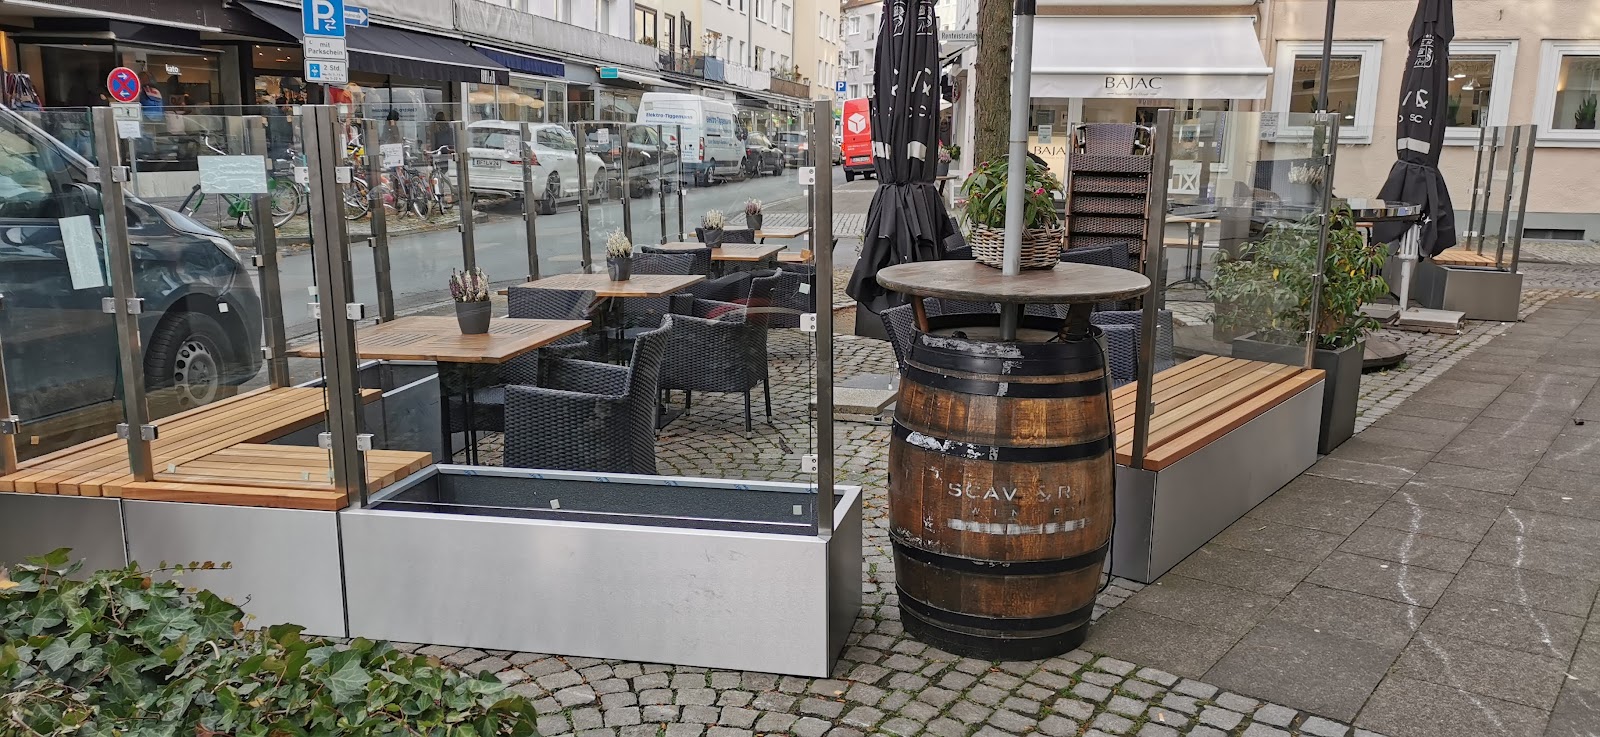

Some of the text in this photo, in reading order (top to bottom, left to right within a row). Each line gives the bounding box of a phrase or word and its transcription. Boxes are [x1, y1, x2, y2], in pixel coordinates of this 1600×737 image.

[312, 0, 334, 30] P
[838, 82, 844, 91] P
[1105, 76, 1162, 90] BAJAC
